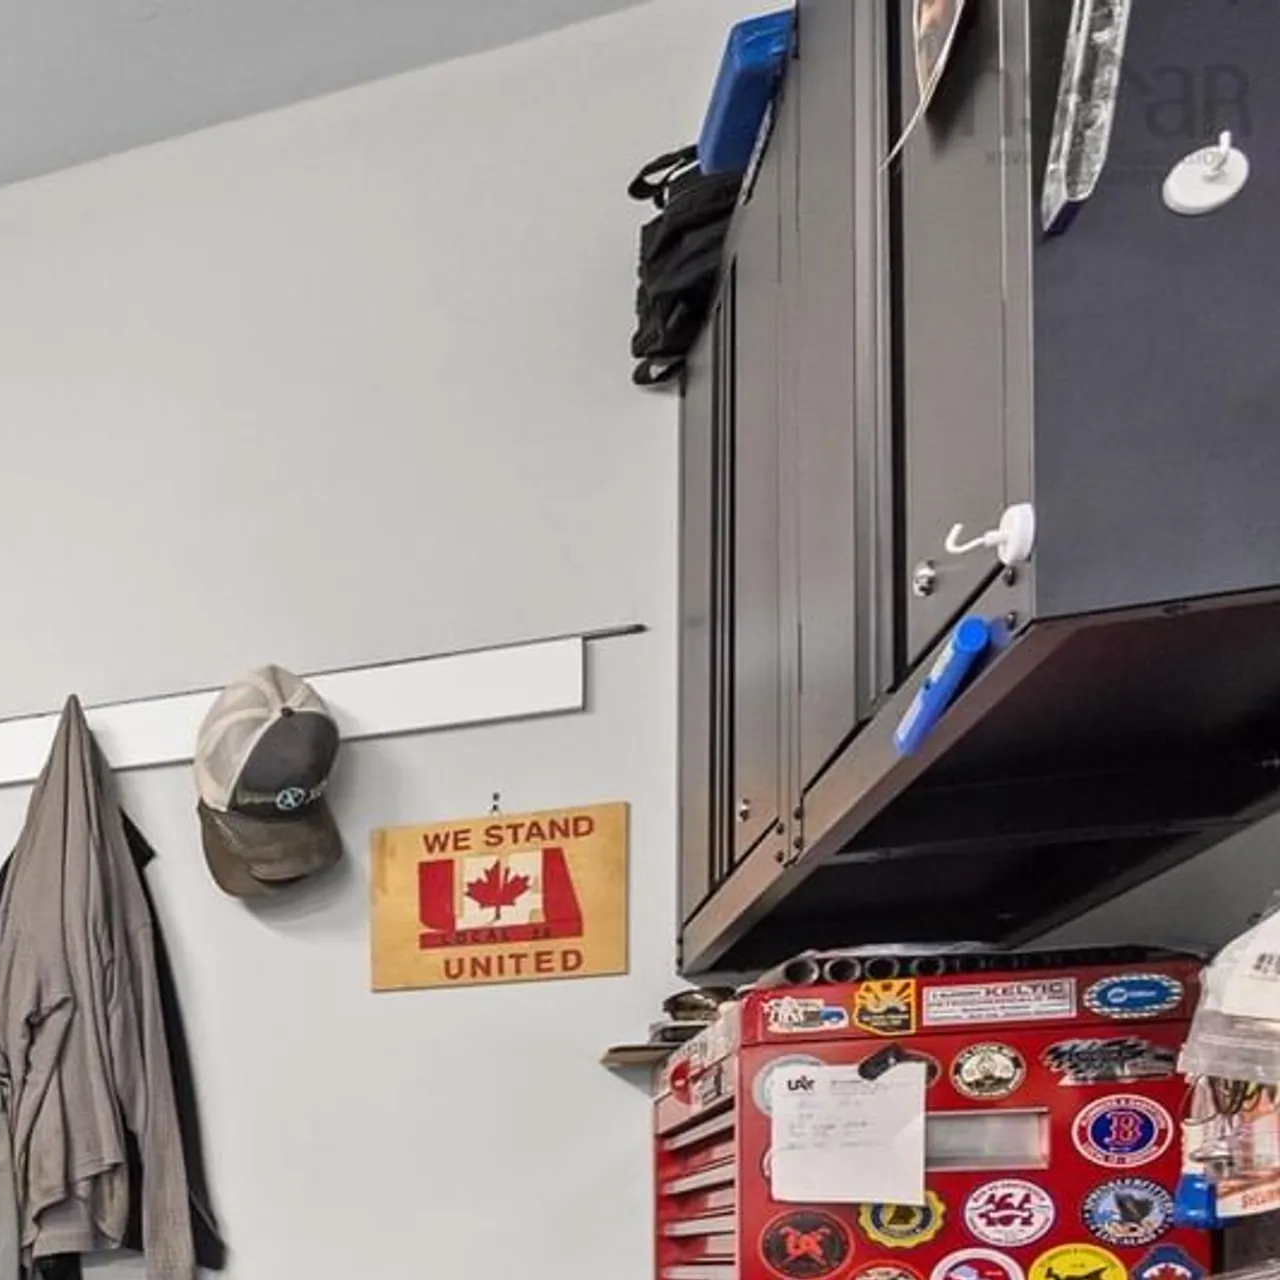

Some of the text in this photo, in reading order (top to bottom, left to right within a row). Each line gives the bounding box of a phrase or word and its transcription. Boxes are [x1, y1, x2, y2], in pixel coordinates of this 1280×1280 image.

[423, 816, 594, 853] WE STAND
[444, 950, 583, 979] UNITED
